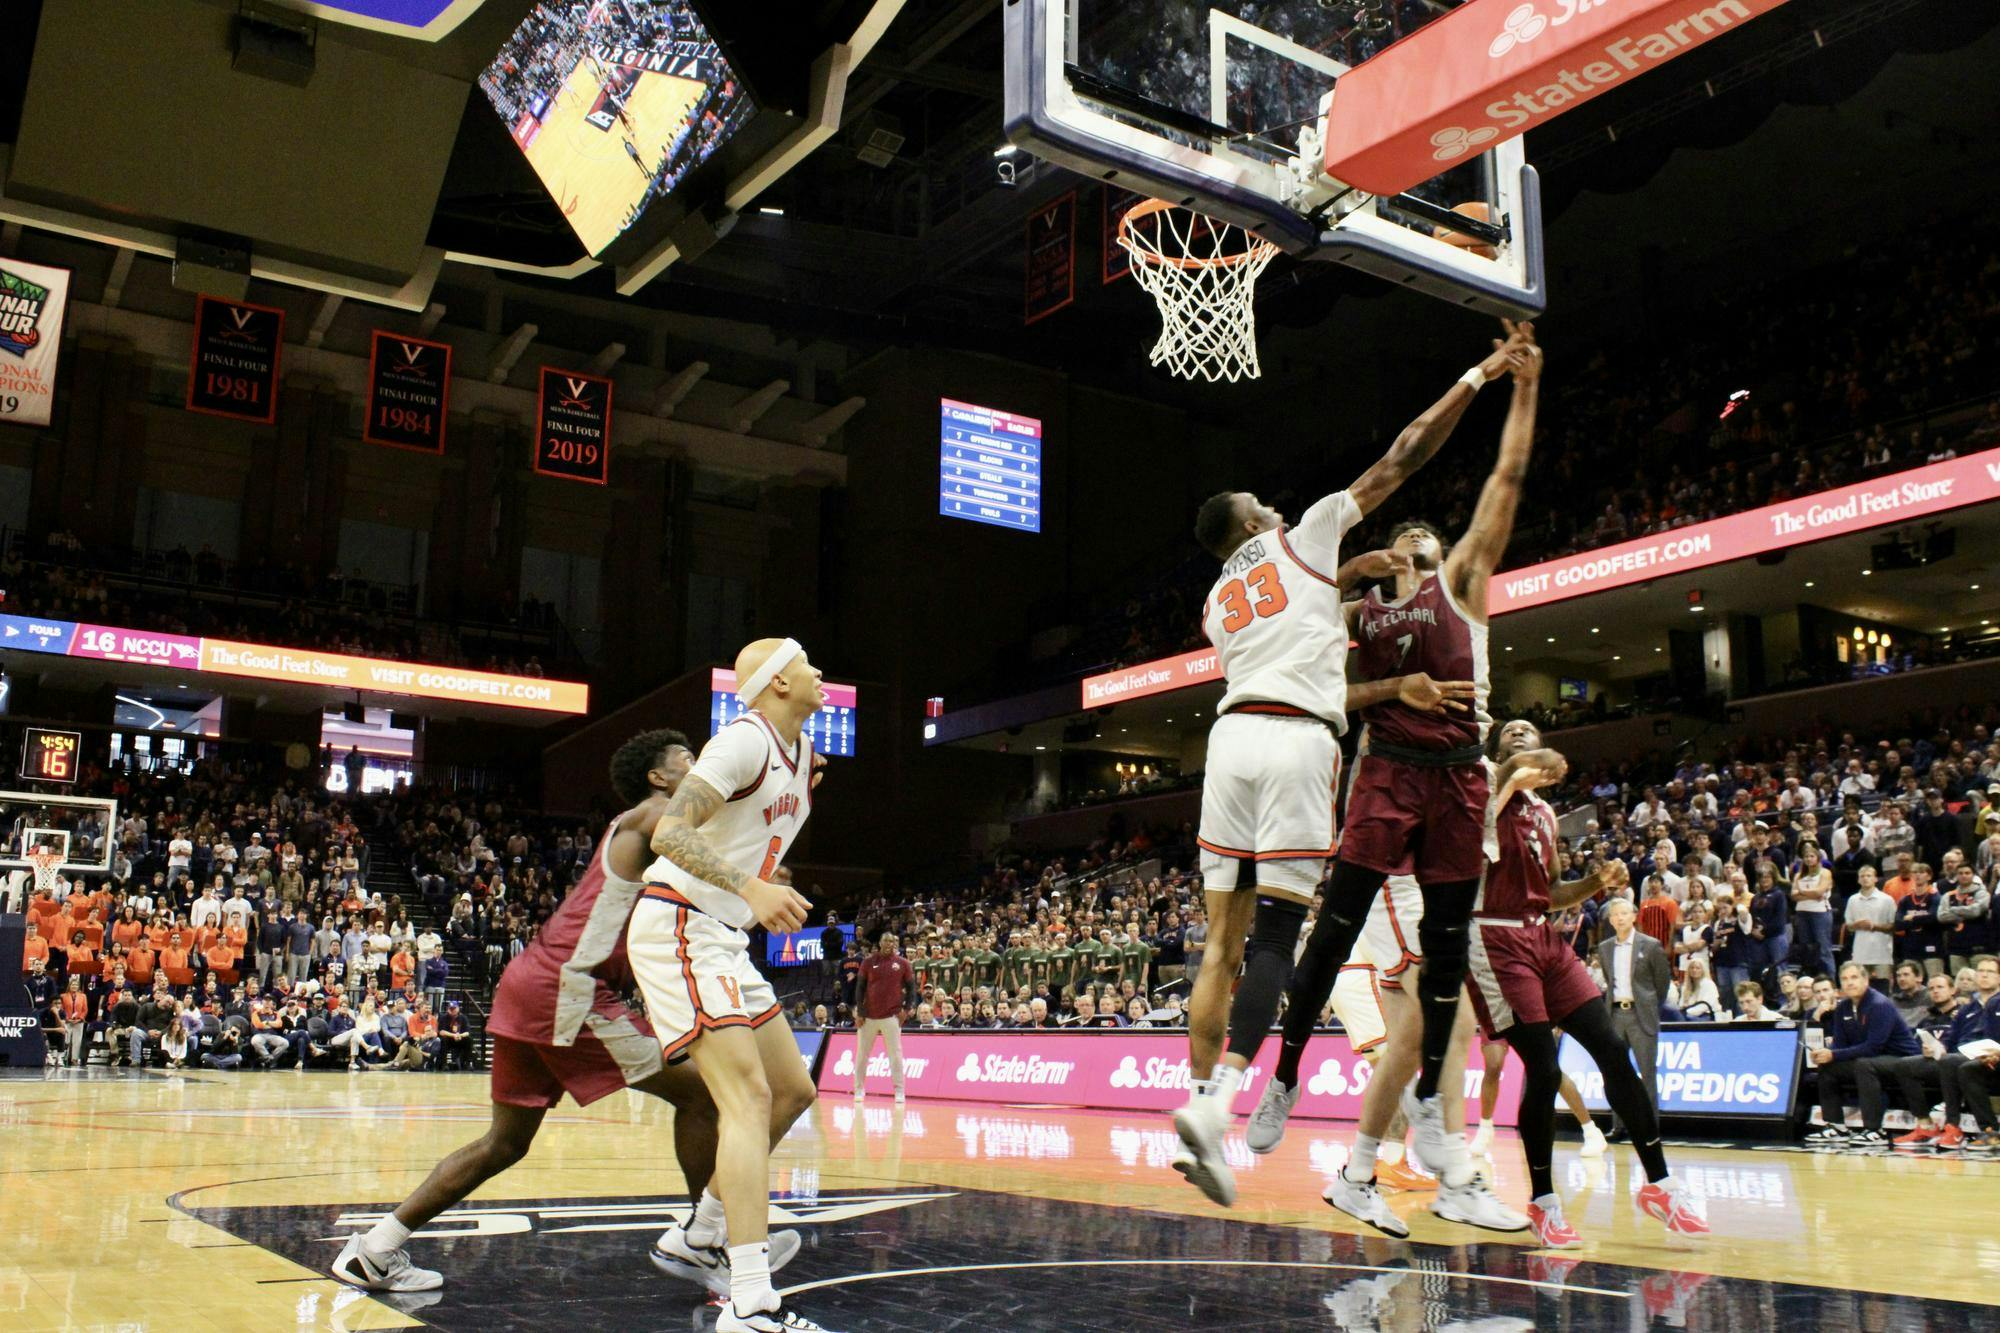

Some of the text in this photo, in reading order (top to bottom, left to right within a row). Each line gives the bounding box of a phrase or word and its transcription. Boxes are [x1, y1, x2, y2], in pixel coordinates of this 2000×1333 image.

[1485, 0, 1750, 129] StateFarm
[203, 352, 268, 373] FINAL FOUR
[206, 372, 260, 403] 1981
[379, 386, 437, 405] FINAL FOUR
[380, 406, 432, 434] 1984
[547, 420, 600, 438] FINAL FOUR
[547, 438, 598, 465] 2019
[1771, 479, 1953, 538] The Good Feet Store
[1505, 534, 1712, 599] VISIT GOODFEET.COM
[1217, 561, 1289, 634] 33
[28, 624, 62, 637] FOULS
[40, 637, 49, 647] 7
[81, 630, 172, 657] 16 NCCU
[211, 647, 347, 679] The Good Feet Store
[1186, 656, 1216, 674] VISIT
[1396, 633, 1413, 669] 7
[371, 667, 551, 701] VISIT GOODFEET.COM
[1088, 670, 1171, 699] The Good Feet Store
[40, 735, 74, 751] 4:54
[42, 751, 66, 776] 16
[763, 793, 800, 826] VIRGIN
[716, 975, 741, 1009] V
[0, 1016, 37, 1028] NITED
[0, 1027, 23, 1038] ANK
[980, 1055, 1070, 1085] StateFarm
